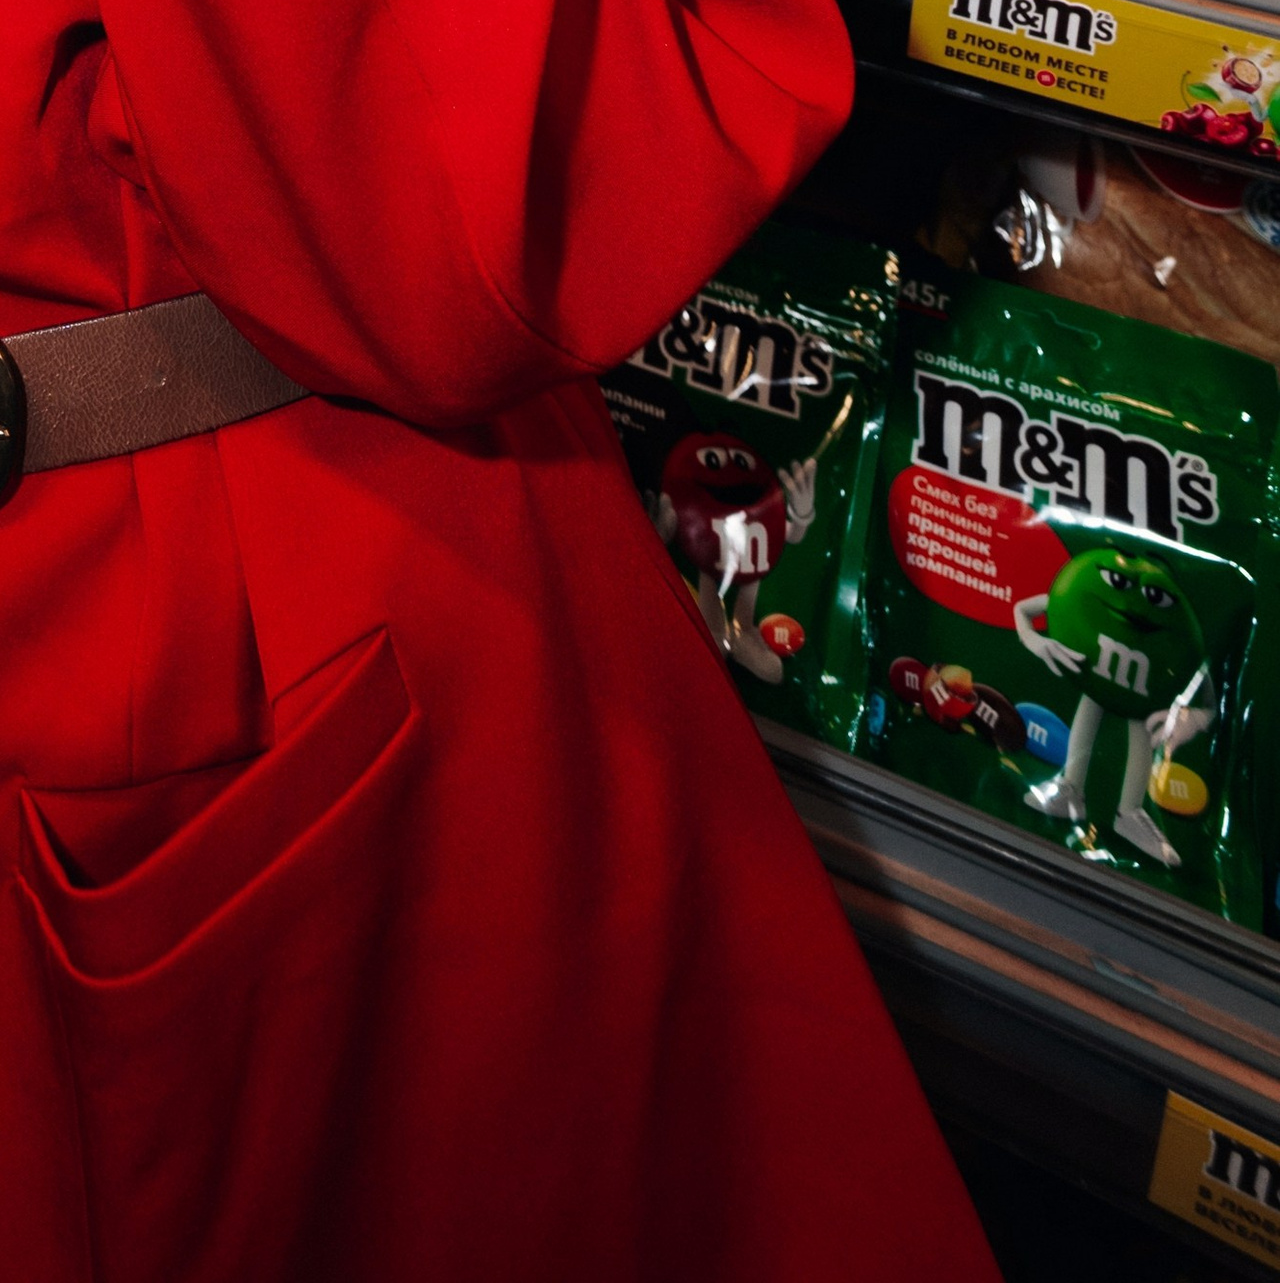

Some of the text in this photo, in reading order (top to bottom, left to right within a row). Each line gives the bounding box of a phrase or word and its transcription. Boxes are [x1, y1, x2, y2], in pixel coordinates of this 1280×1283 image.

[944, 44, 1022, 78] ВЕСЕЛЕЕ
[945, 28, 1110, 83] В ЛЮБОМ МЕСТЕ
[900, 278, 952, 311] 45г
[914, 347, 1001, 387] солёный
[1018, 382, 1122, 422] арахисом
[909, 495, 993, 538] причины
[912, 476, 999, 521] Смех без
[905, 532, 998, 577] хорошей
[907, 512, 992, 558] признак
[904, 551, 1013, 603] компании!
